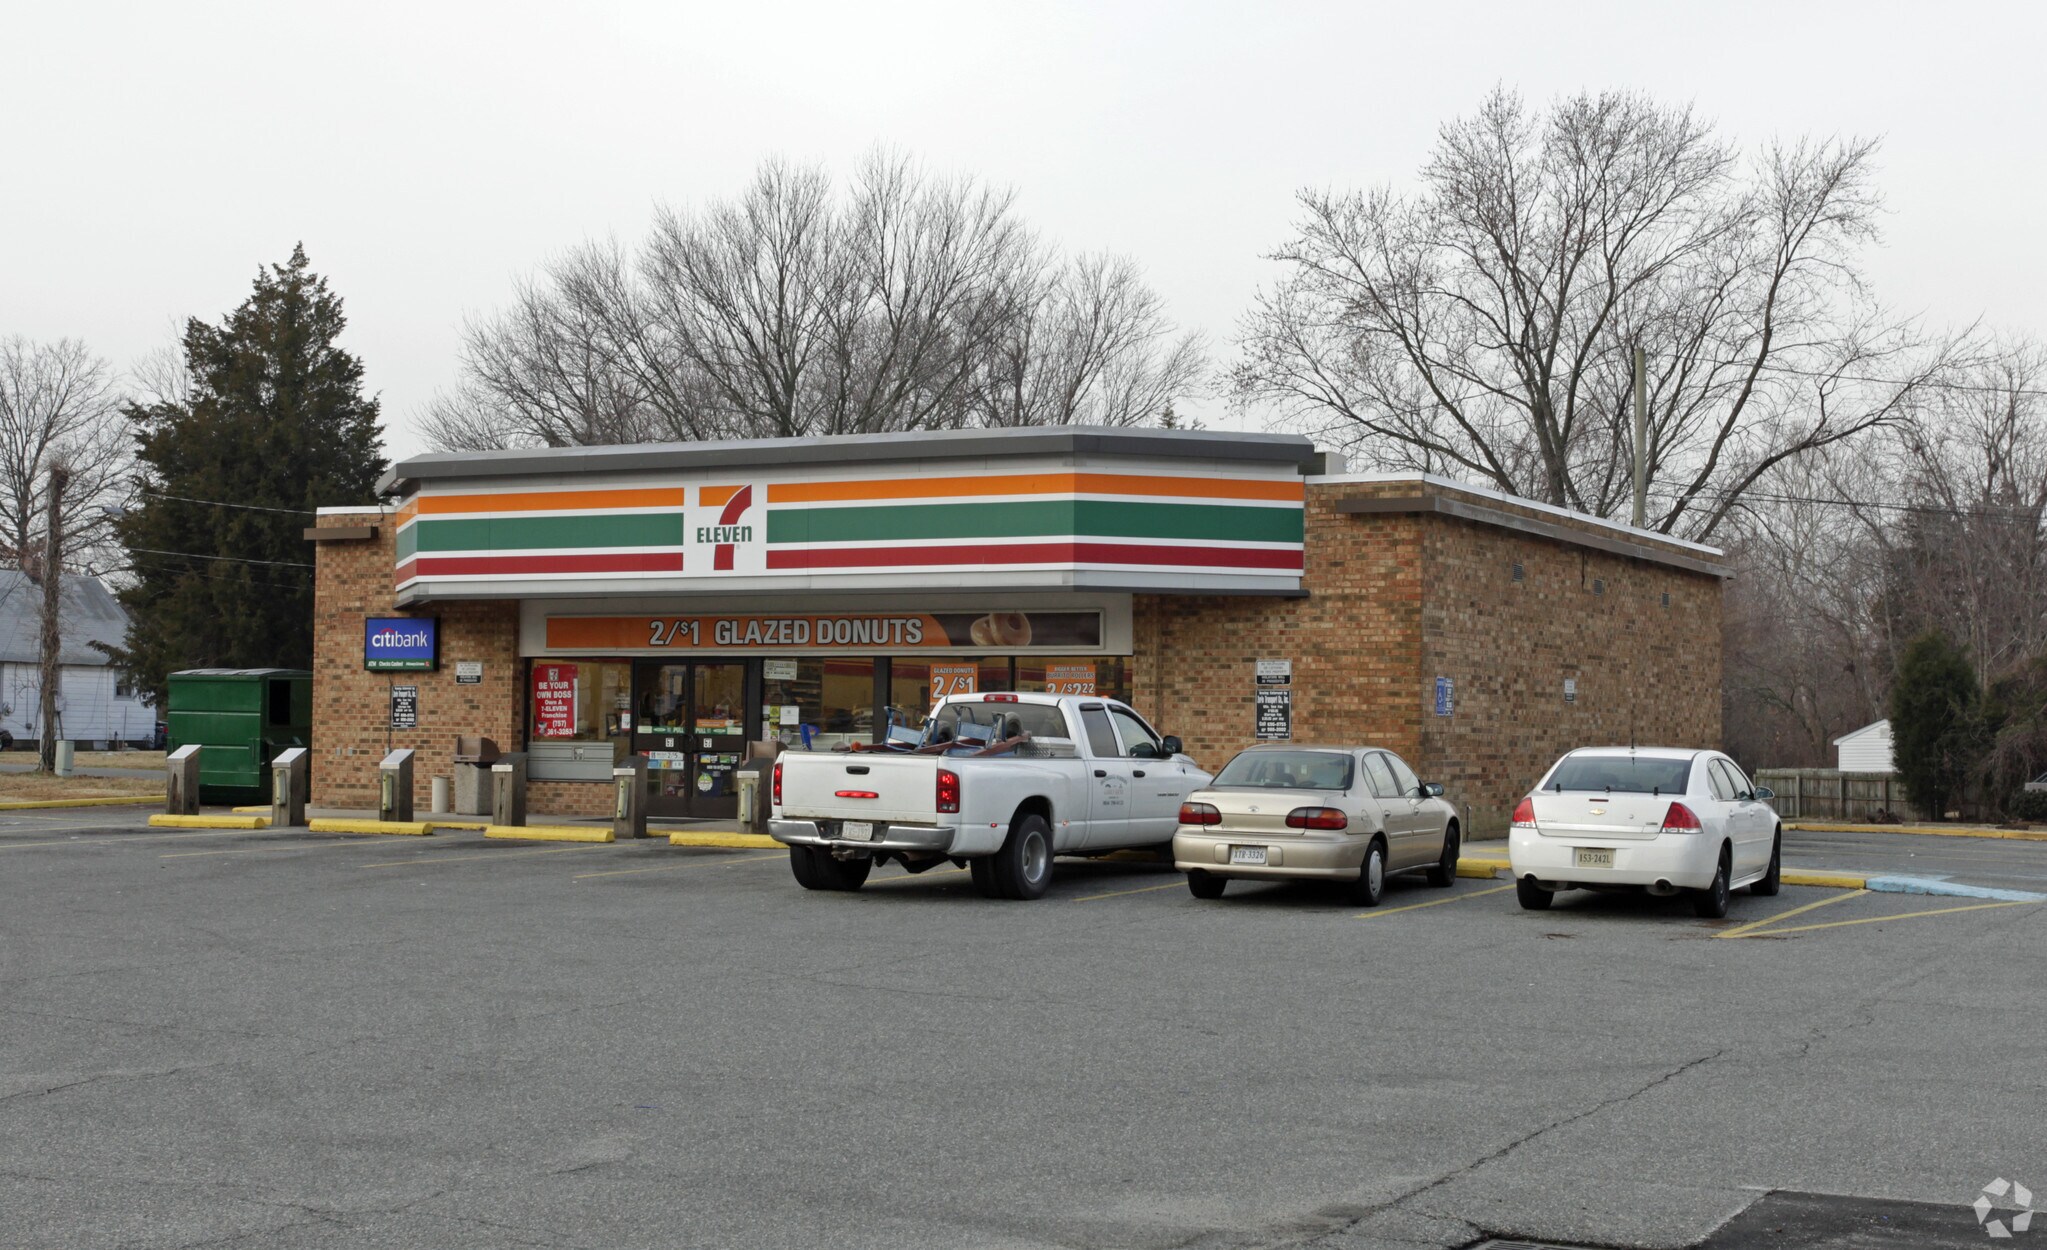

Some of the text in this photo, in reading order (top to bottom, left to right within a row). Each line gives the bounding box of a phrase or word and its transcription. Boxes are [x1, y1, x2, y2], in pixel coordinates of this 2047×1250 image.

[371, 629, 428, 648] citibank
[649, 618, 923, 646] 2/$1 GLAZED DONUTS
[538, 682, 568, 690] BE YOUR
[554, 690, 572, 698] BOSS
